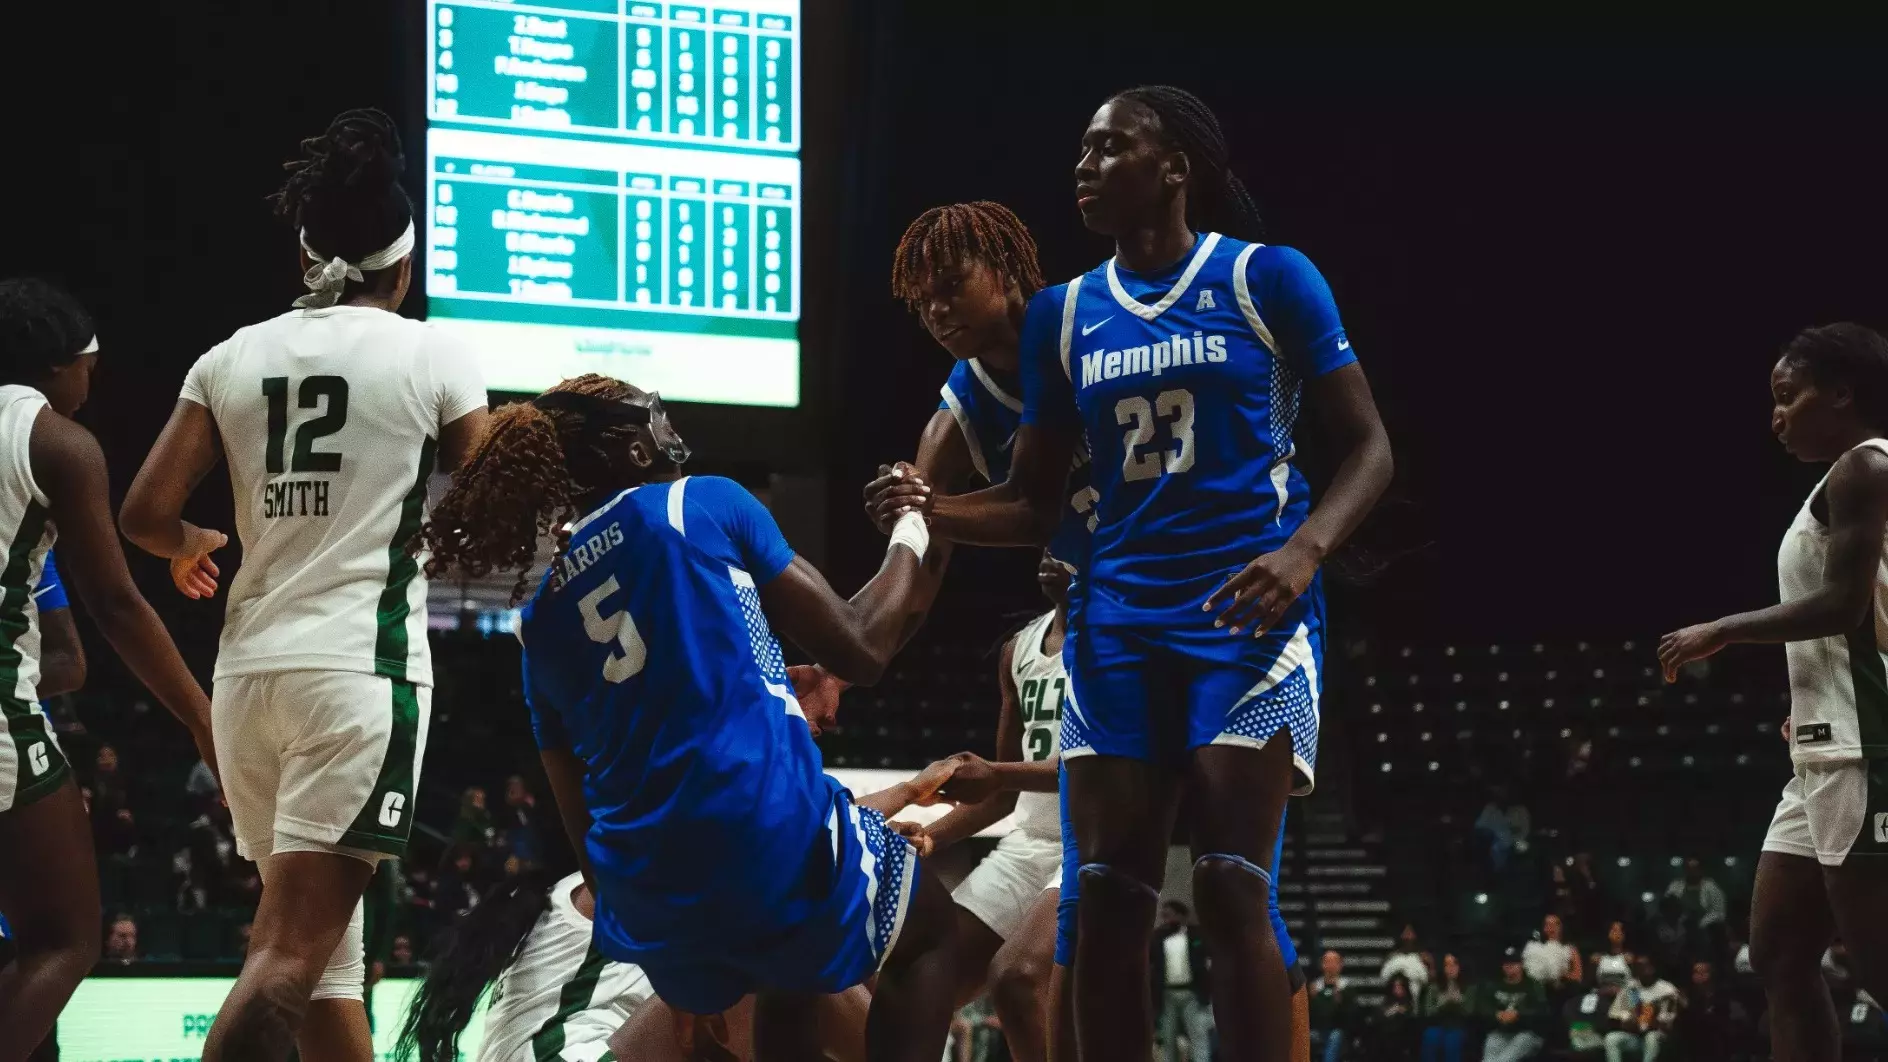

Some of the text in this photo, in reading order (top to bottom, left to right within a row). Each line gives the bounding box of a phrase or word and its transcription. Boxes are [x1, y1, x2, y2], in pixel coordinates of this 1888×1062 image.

[1080, 331, 1228, 389] Memphis
[262, 375, 349, 474] 12
[1114, 388, 1196, 482] 23
[264, 480, 330, 519] SMITH
[577, 573, 647, 684] 5
